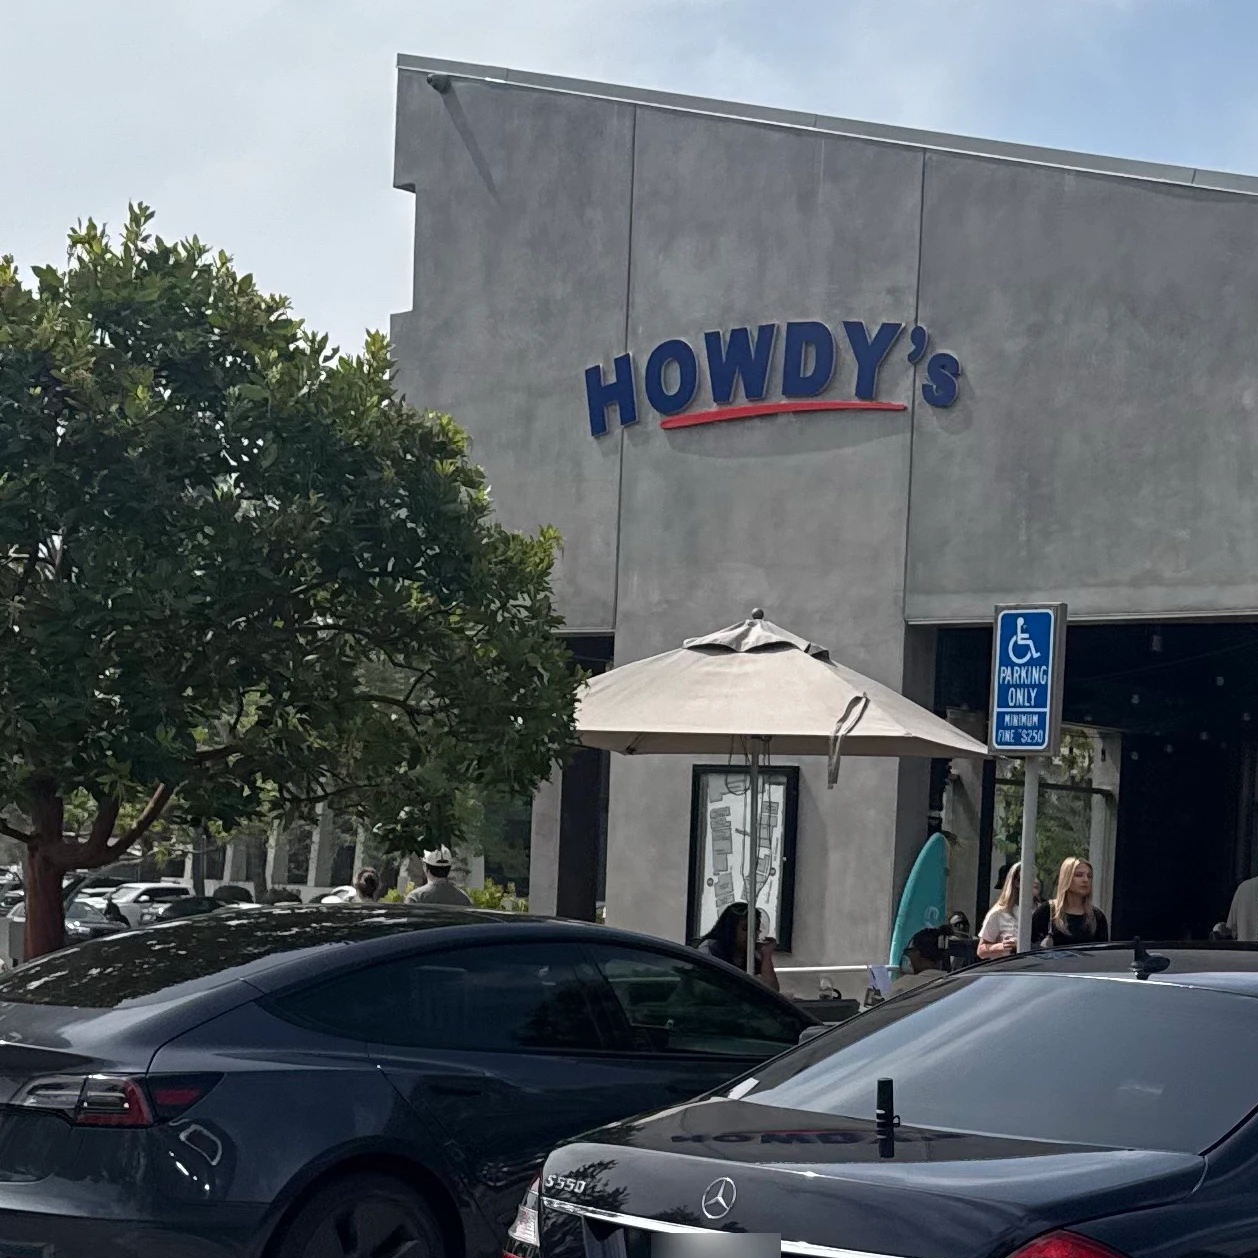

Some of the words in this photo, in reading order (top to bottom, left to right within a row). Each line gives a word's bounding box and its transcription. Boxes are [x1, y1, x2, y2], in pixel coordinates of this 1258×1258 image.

[584, 319, 963, 438] HOWDY's
[999, 665, 1048, 685] PARKING
[1007, 687, 1038, 707] ONLY
[1004, 713, 1039, 727] MINIMUM
[997, 729, 1015, 743] FINE
[1020, 729, 1044, 743] $250
